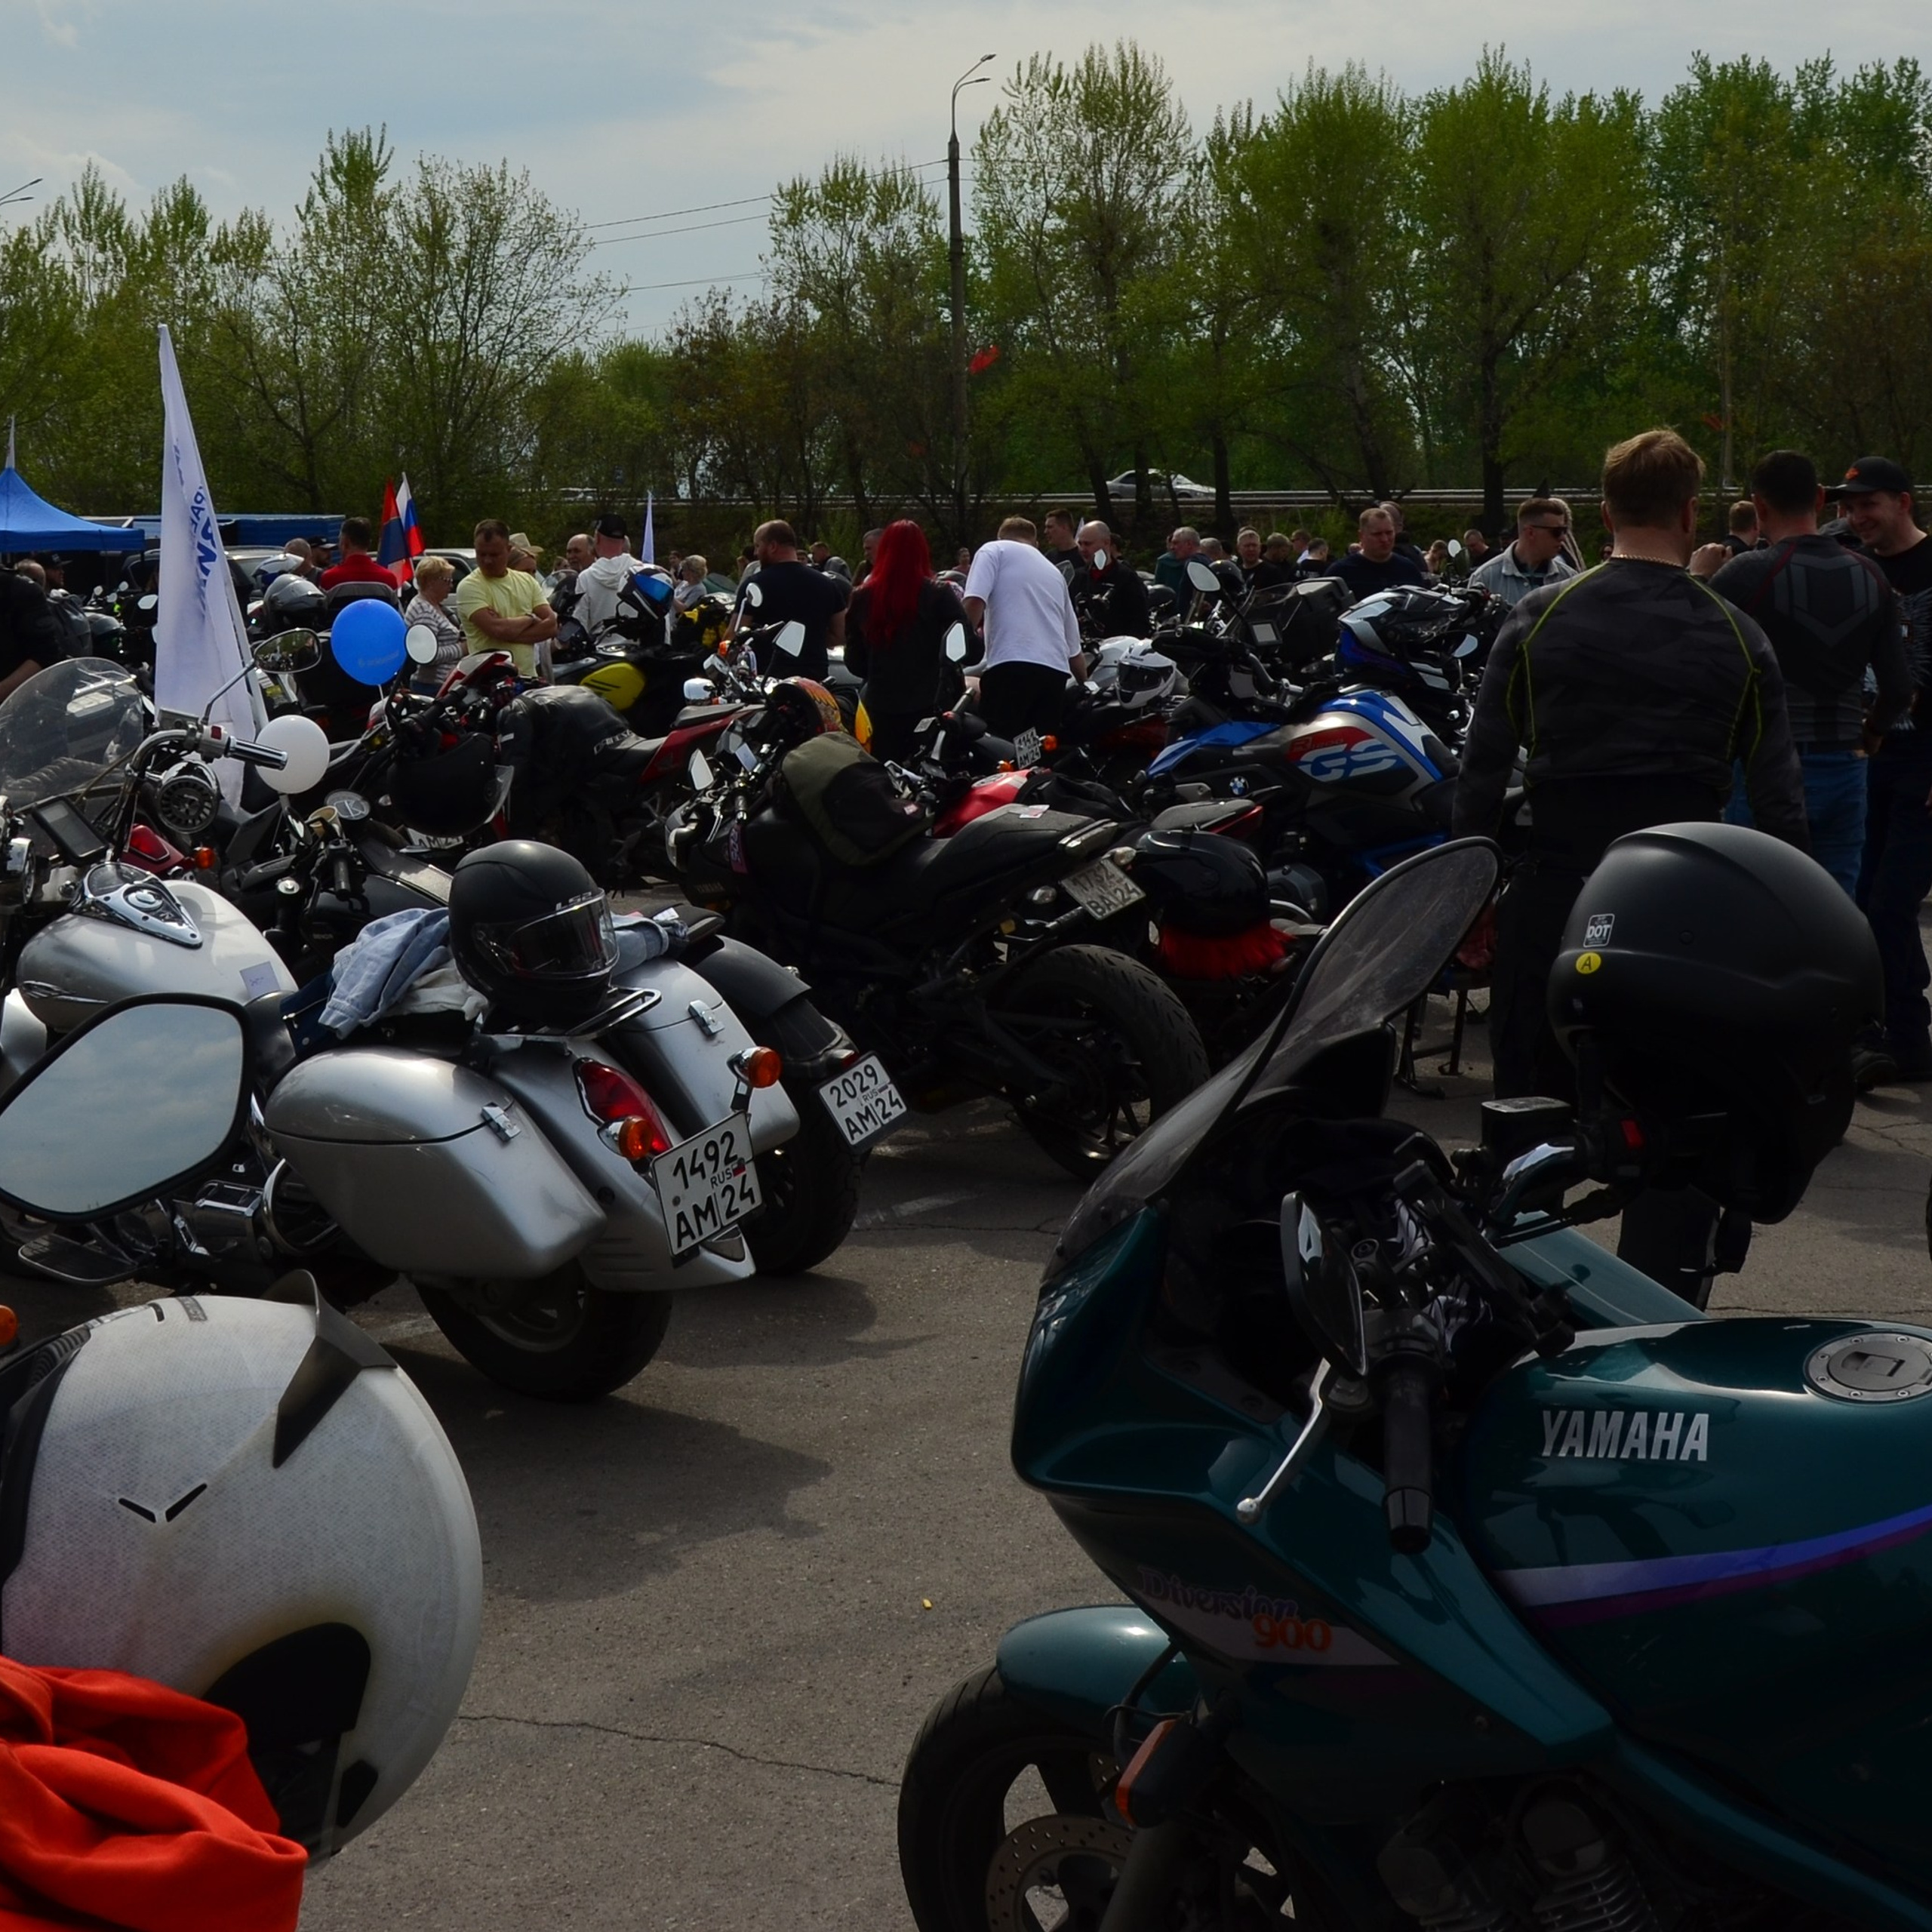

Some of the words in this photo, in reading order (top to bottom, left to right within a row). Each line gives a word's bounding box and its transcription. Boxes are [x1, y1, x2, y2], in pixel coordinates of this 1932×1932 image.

[1297, 738, 1397, 783] GS
[555, 891, 592, 912] LS2
[1087, 894, 1119, 915] BA
[1115, 882, 1141, 904] 24
[1586, 924, 1611, 939] DOT
[1580, 955, 1592, 971] A
[829, 1063, 878, 1109] 2029
[861, 1089, 879, 1103] RUS
[844, 1105, 878, 1141] AM
[875, 1090, 903, 1121] 24
[672, 1131, 738, 1190] 1492
[709, 1168, 733, 1189] RUS
[676, 1195, 718, 1248] AM
[721, 1174, 755, 1220] 24
[1541, 1410, 1710, 1462] YAMAHA
[1137, 1564, 1301, 1621] Diversion
[1252, 1612, 1333, 1653] 900
